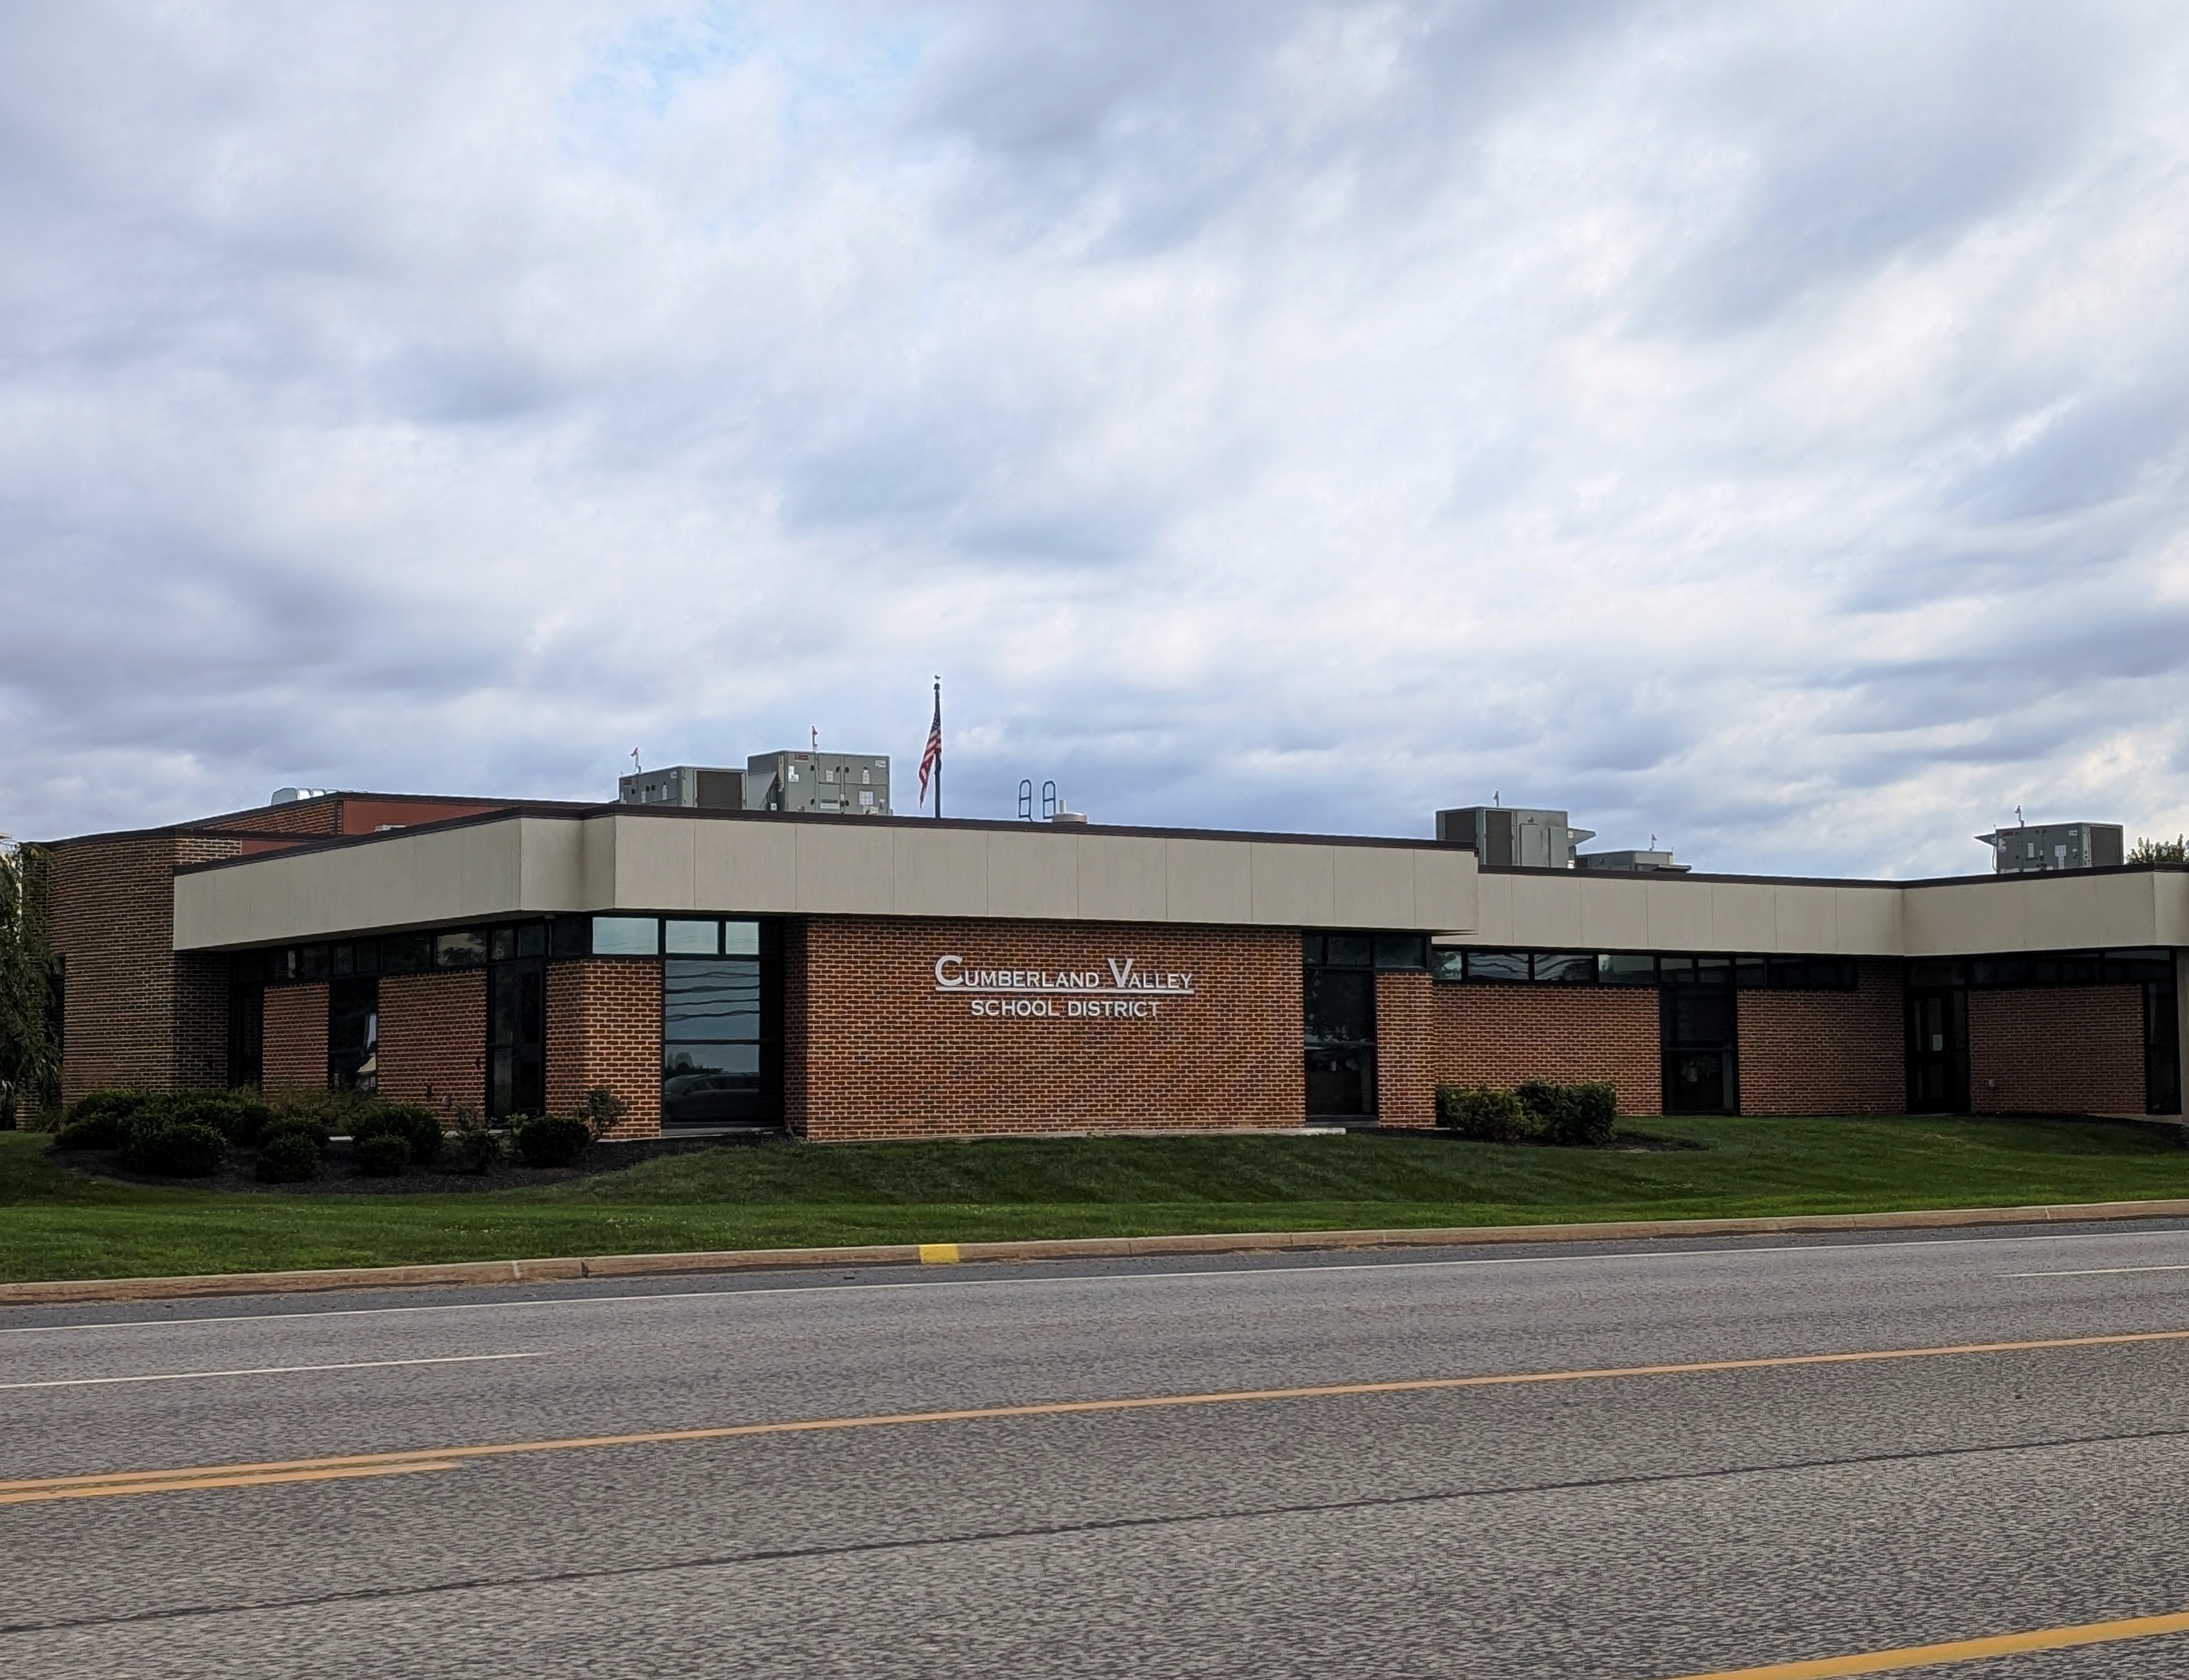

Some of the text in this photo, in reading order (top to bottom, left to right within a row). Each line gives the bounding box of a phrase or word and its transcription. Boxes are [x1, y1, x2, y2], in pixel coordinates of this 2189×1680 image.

[935, 955, 1193, 989] CUMBERLAND VALLEY
[971, 1000, 1161, 1018] SCHOOL DISTRICT
